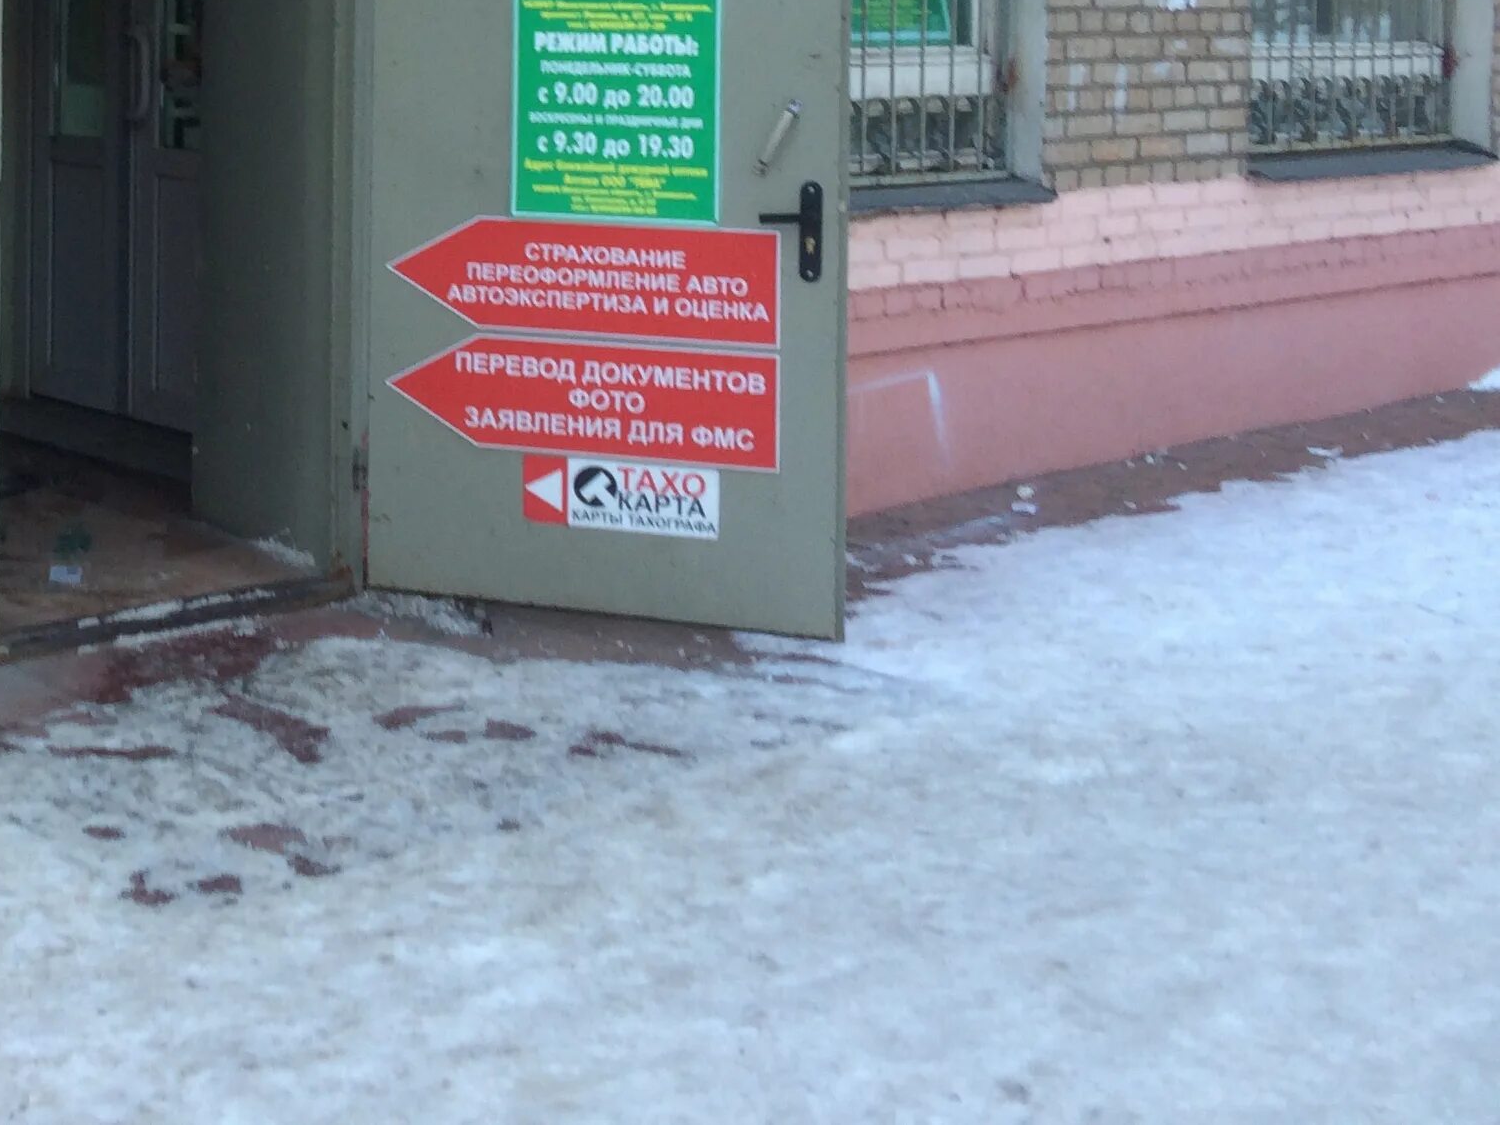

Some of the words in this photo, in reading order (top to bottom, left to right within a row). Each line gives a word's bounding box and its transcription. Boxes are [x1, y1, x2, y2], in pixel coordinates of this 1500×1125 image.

[534, 31, 607, 54] РЕЖИМ
[610, 33, 699, 56] РАБОТЫ:
[537, 86, 548, 103] с
[553, 81, 598, 105] 9.00
[603, 89, 631, 109] до
[637, 84, 695, 109] 20.00
[537, 135, 548, 153] с
[553, 130, 598, 155] 9.30
[603, 138, 630, 159] до
[638, 134, 694, 159] 19.30
[524, 242, 686, 270] СТРАХОВАНИЕ
[467, 261, 679, 293] ПЕРЕОФОРМЛЕНИЕ
[686, 275, 748, 297] АВТО
[447, 284, 647, 315] АВТОЭКСПЕРТИЗА
[653, 298, 669, 316] И
[675, 298, 770, 323] ОЦЕНКА
[455, 350, 576, 383] ПЕРЕВОД
[582, 359, 766, 395] ДОКУМЕНТОВ
[569, 388, 645, 414] ФОТО
[465, 406, 621, 440] ЗАЯВЛЕНИЯ
[628, 421, 683, 446] ДЛЯ
[692, 426, 755, 452] ФМС
[617, 466, 706, 497] ТАХО
[617, 490, 706, 519] КАРТА
[572, 508, 622, 527] КАРТЫ
[626, 514, 716, 535] ТАХОГРАФА
